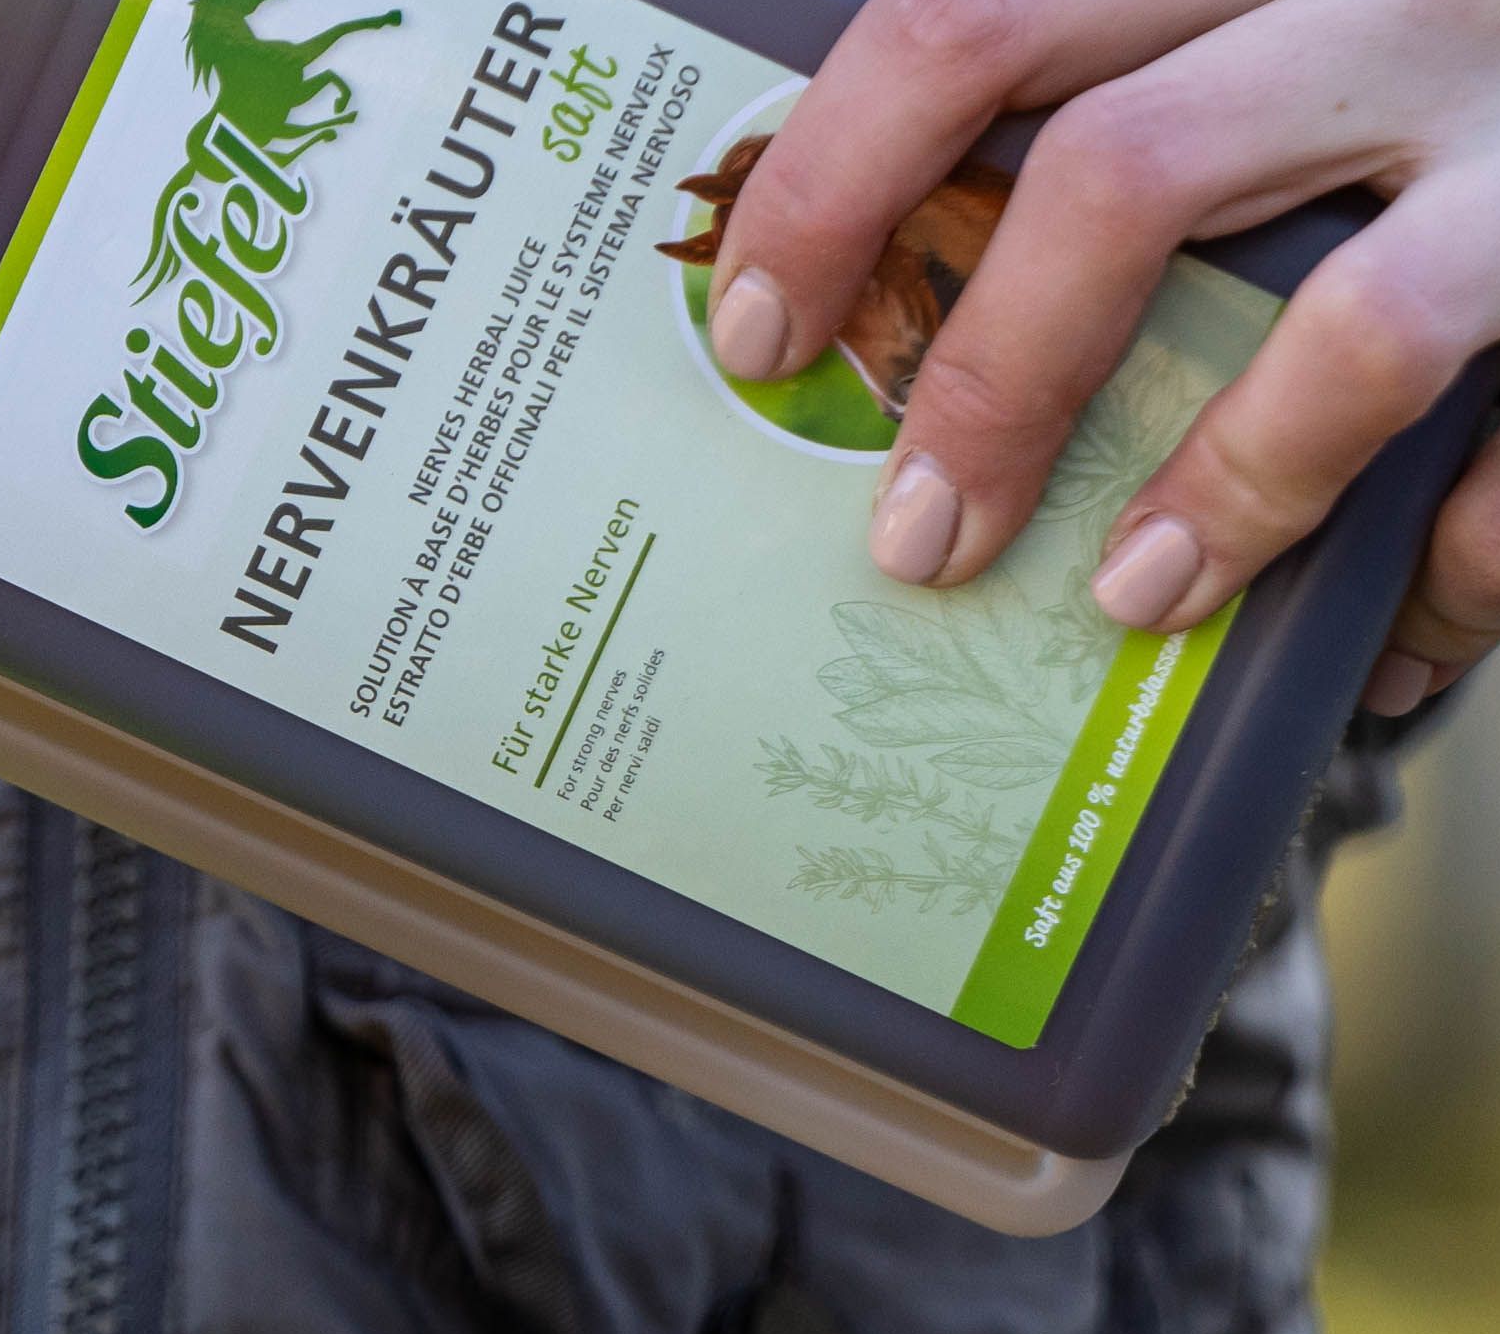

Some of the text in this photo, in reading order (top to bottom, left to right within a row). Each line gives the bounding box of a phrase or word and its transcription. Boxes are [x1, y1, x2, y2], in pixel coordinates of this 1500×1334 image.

[541, 44, 618, 163] saft
[604, 42, 674, 161] NERVEUX
[629, 64, 700, 187] NERVOSO
[551, 161, 619, 278] SYSTÈME
[578, 193, 645, 300] SISTEMA
[76, 122, 308, 530] Stiefel
[218, 1, 565, 655] NERVENKRÄUTER
[500, 313, 550, 385] POUR
[534, 278, 564, 311] LE
[542, 329, 580, 378] PER
[565, 307, 592, 327] IL
[406, 235, 547, 506] NERVES HERBAL JUICE
[480, 379, 556, 513] OFFICINALI
[400, 576, 430, 597] À
[414, 505, 460, 572] BASE
[349, 596, 418, 718] SOLUTION
[381, 607, 450, 727] ESTRATTO
[490, 498, 640, 775] Für starke Nerven
[555, 668, 627, 801] For strong nerves
[579, 648, 665, 812] Pour des nerfs solides
[601, 716, 662, 823] Per nervi saldi
[1023, 894, 1063, 948] Saft
[1051, 852, 1083, 895] aus
[1067, 808, 1101, 853] 100
[1085, 781, 1117, 806] %
